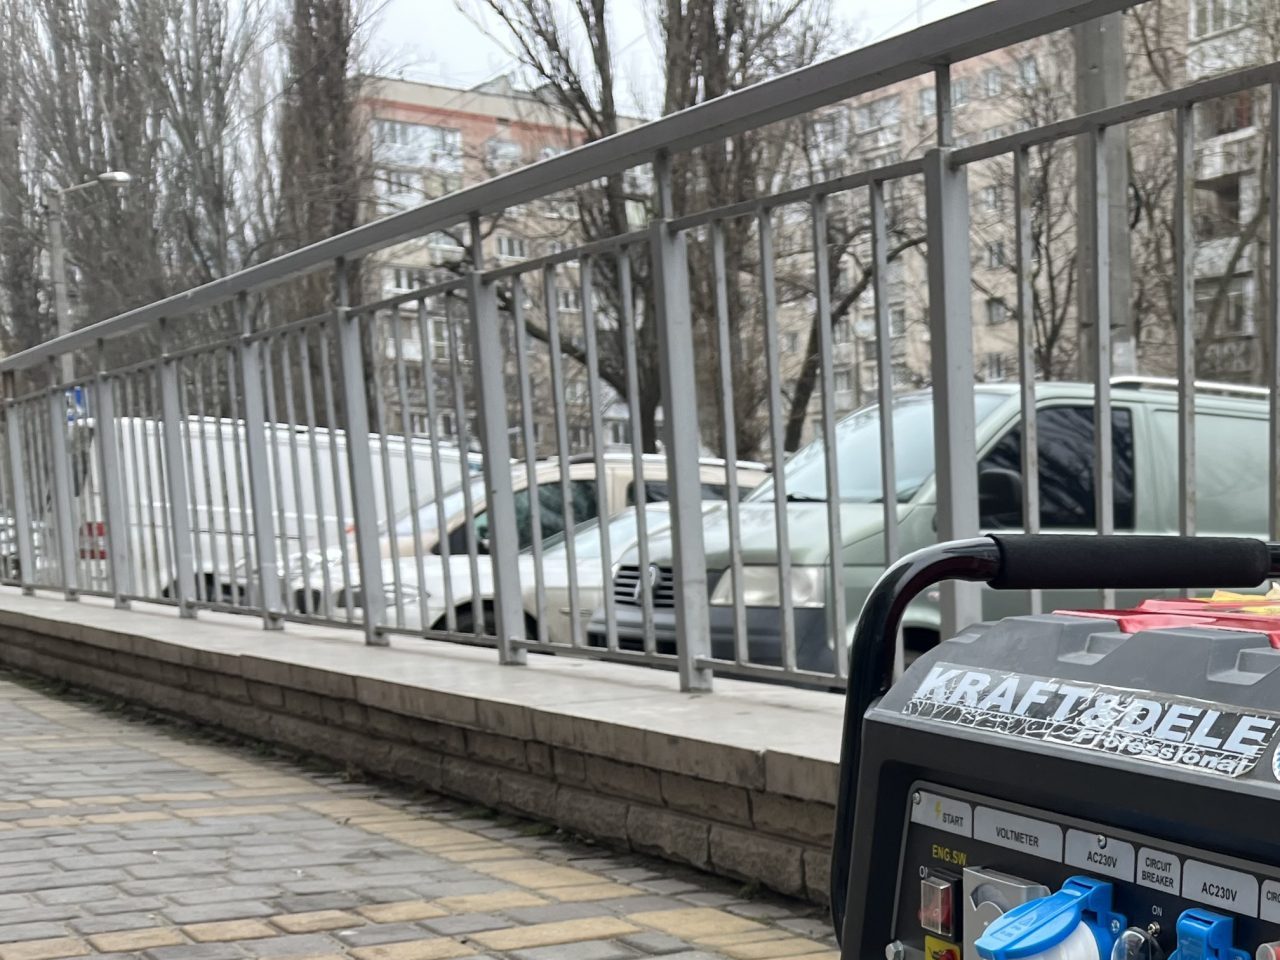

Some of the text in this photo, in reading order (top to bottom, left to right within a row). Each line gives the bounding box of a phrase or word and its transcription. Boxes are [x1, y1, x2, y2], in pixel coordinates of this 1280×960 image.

[913, 667, 1276, 755] KRAFT&DELE
[942, 812, 964, 828] START
[995, 826, 1039, 848] VOLTMETER
[1086, 850, 1118, 869] AC230V
[1145, 857, 1172, 873] CIRCUIT
[1141, 870, 1174, 889] BREAKER
[1201, 881, 1238, 902] AC230V
[1152, 905, 1163, 917] ON
